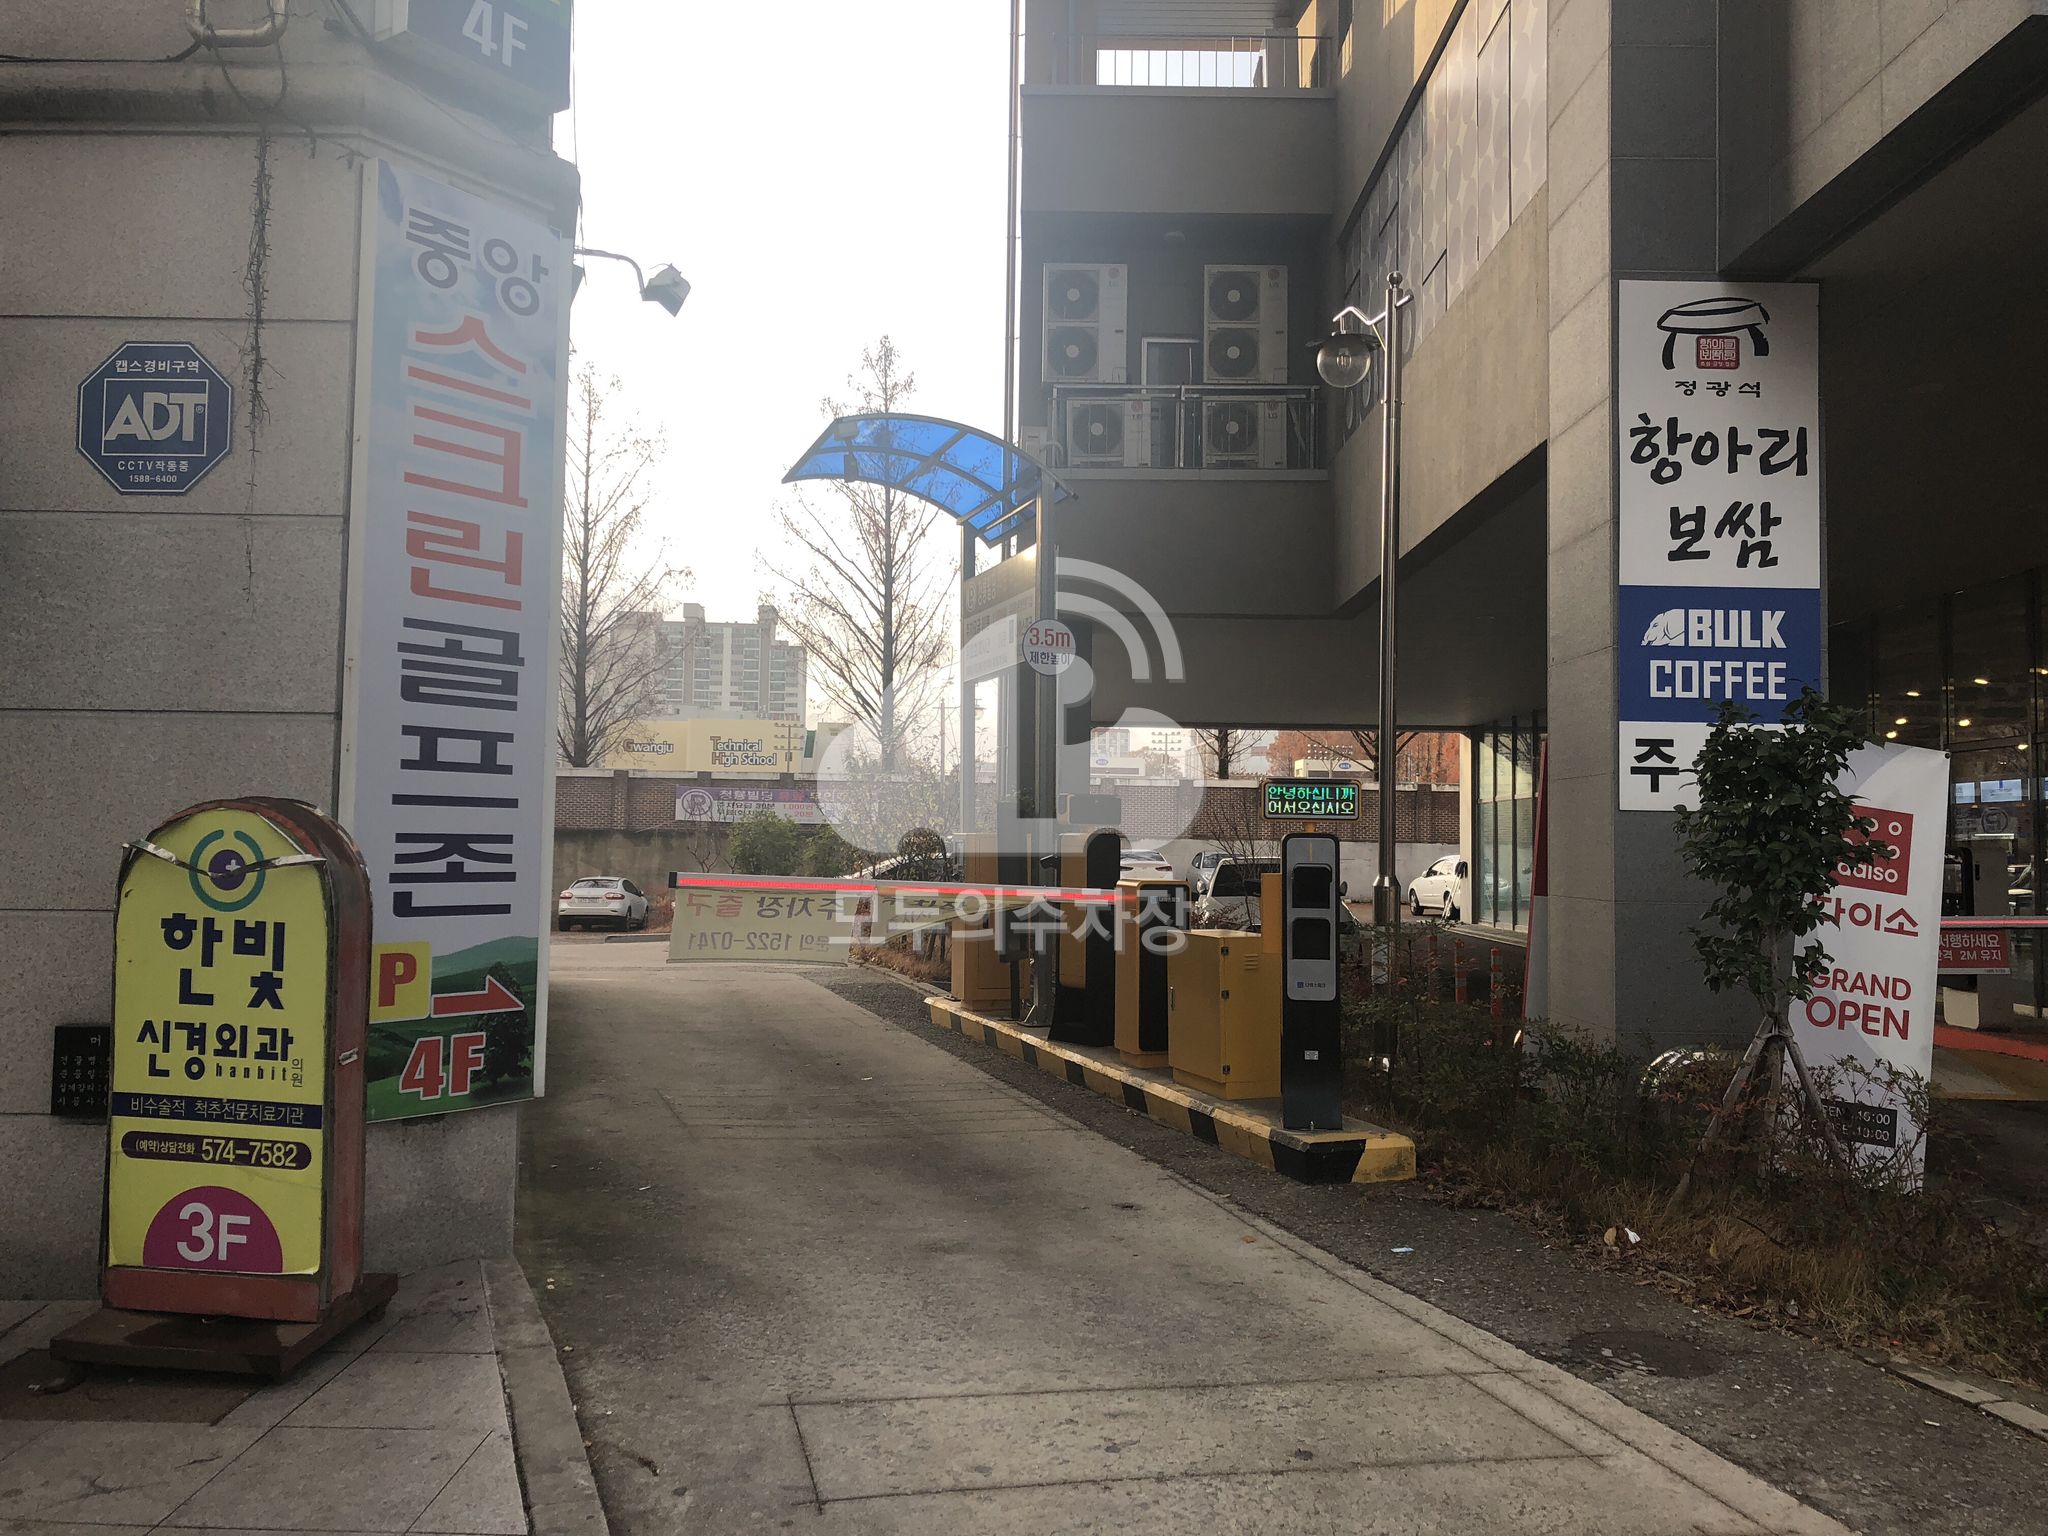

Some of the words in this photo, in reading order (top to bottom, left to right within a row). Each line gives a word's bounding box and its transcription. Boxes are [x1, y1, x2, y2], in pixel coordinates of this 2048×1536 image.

[462, 0, 529, 67] 4F
[405, 207, 550, 317] 중앙
[115, 359, 200, 374] 캡스경비구역
[1675, 380, 1761, 398] 정광석
[103, 391, 208, 442] ADT
[1629, 412, 1808, 485] 항아리
[117, 460, 190, 473] CCTV작동중
[129, 474, 178, 484] 1588-6400
[1667, 500, 1783, 569] 보쌈
[1029, 627, 1072, 648] 3.5m
[1688, 608, 1788, 649] BULK
[1029, 651, 1071, 666] 제한높이
[1650, 659, 1787, 700] COFFEE
[623, 738, 673, 755] Gwangju
[710, 736, 763, 752] Technical
[712, 753, 739, 767] High
[740, 753, 777, 766] School
[1268, 786, 1355, 801] 안녕하십니까
[1268, 801, 1355, 815] 어서오십시오
[161, 912, 286, 1010] 한빛
[377, 952, 418, 1008] P
[1808, 968, 1912, 1001] GRAND
[1805, 995, 1910, 1041] OPEN
[136, 1020, 294, 1081] 신경외과
[400, 1032, 486, 1100] 4F
[215, 1062, 288, 1082] hanbit
[290, 1058, 304, 1088] 의원
[131, 1096, 186, 1117] 비수술적
[194, 1100, 304, 1125] 척추전문치료기관
[135, 1139, 196, 1155] (예약)상담전화
[201, 1137, 298, 1168] 574-7582
[176, 1202, 251, 1263] 3F
